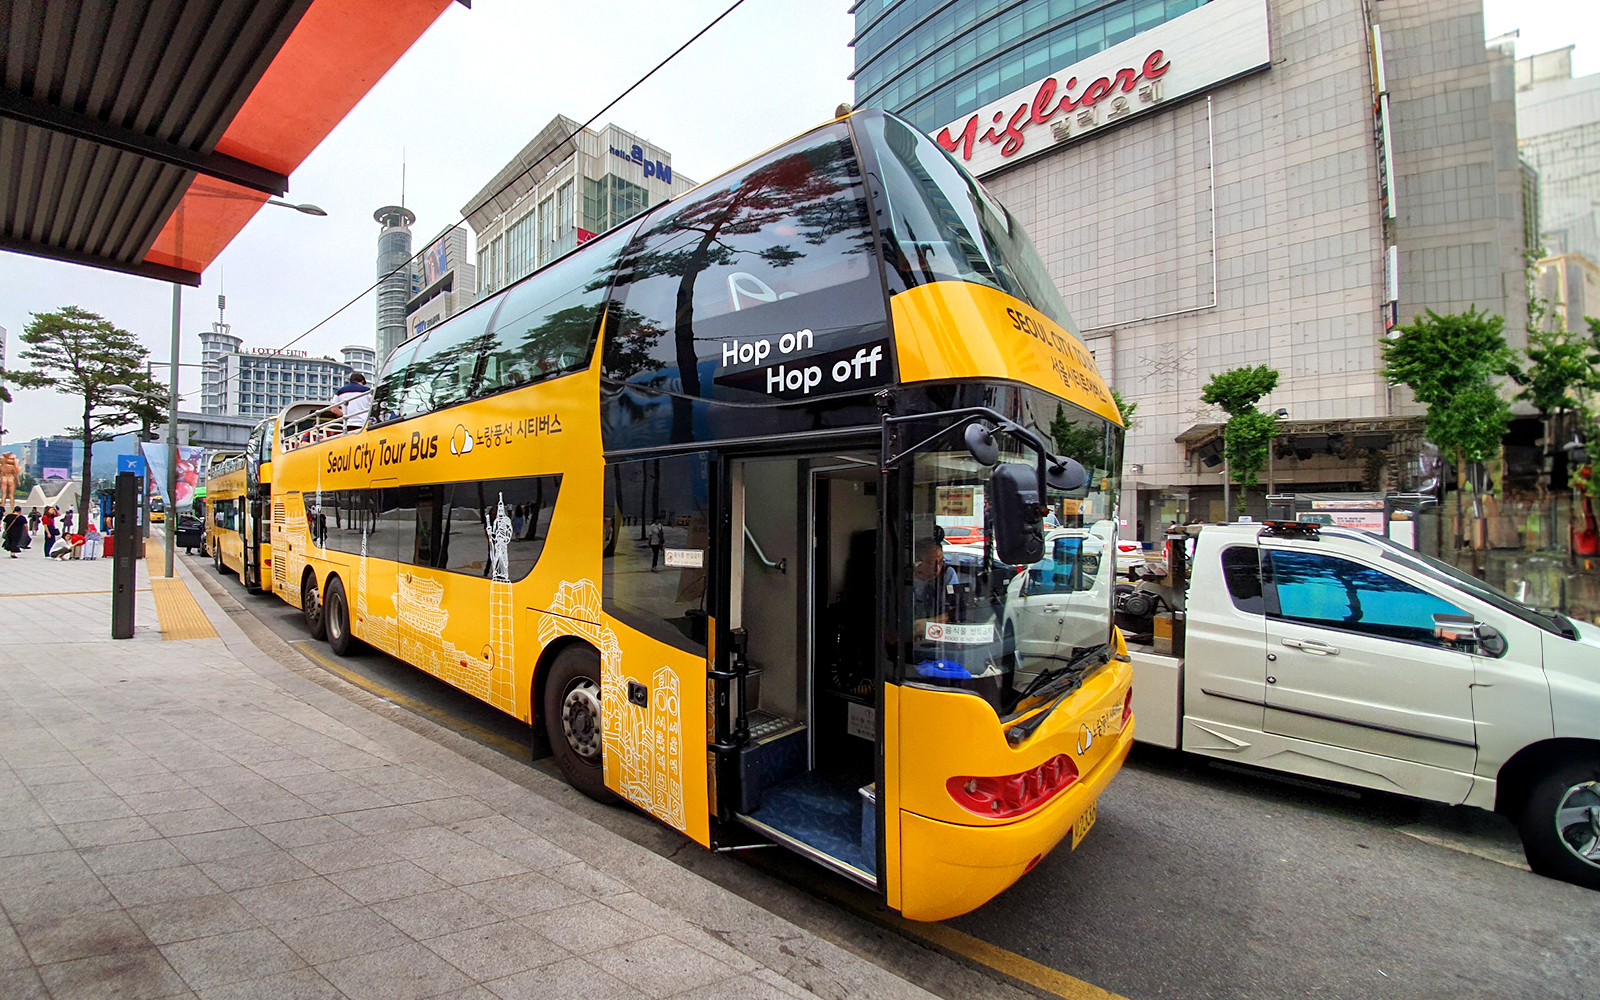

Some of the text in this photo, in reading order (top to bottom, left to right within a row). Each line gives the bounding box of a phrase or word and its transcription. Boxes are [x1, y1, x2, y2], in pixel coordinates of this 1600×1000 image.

[936, 49, 1171, 160] Migliore
[1050, 78, 1164, 142] 밀리오레
[609, 144, 631, 162] hello
[722, 328, 814, 367] Hop on
[1006, 307, 1053, 347] SEOUL
[1051, 331, 1074, 360] CITY
[766, 345, 883, 394] Hop off
[476, 414, 562, 447] 노랑풍선 시티버스
[327, 431, 438, 474] Seoul City Tour Bus
[657, 790, 666, 808] 2
